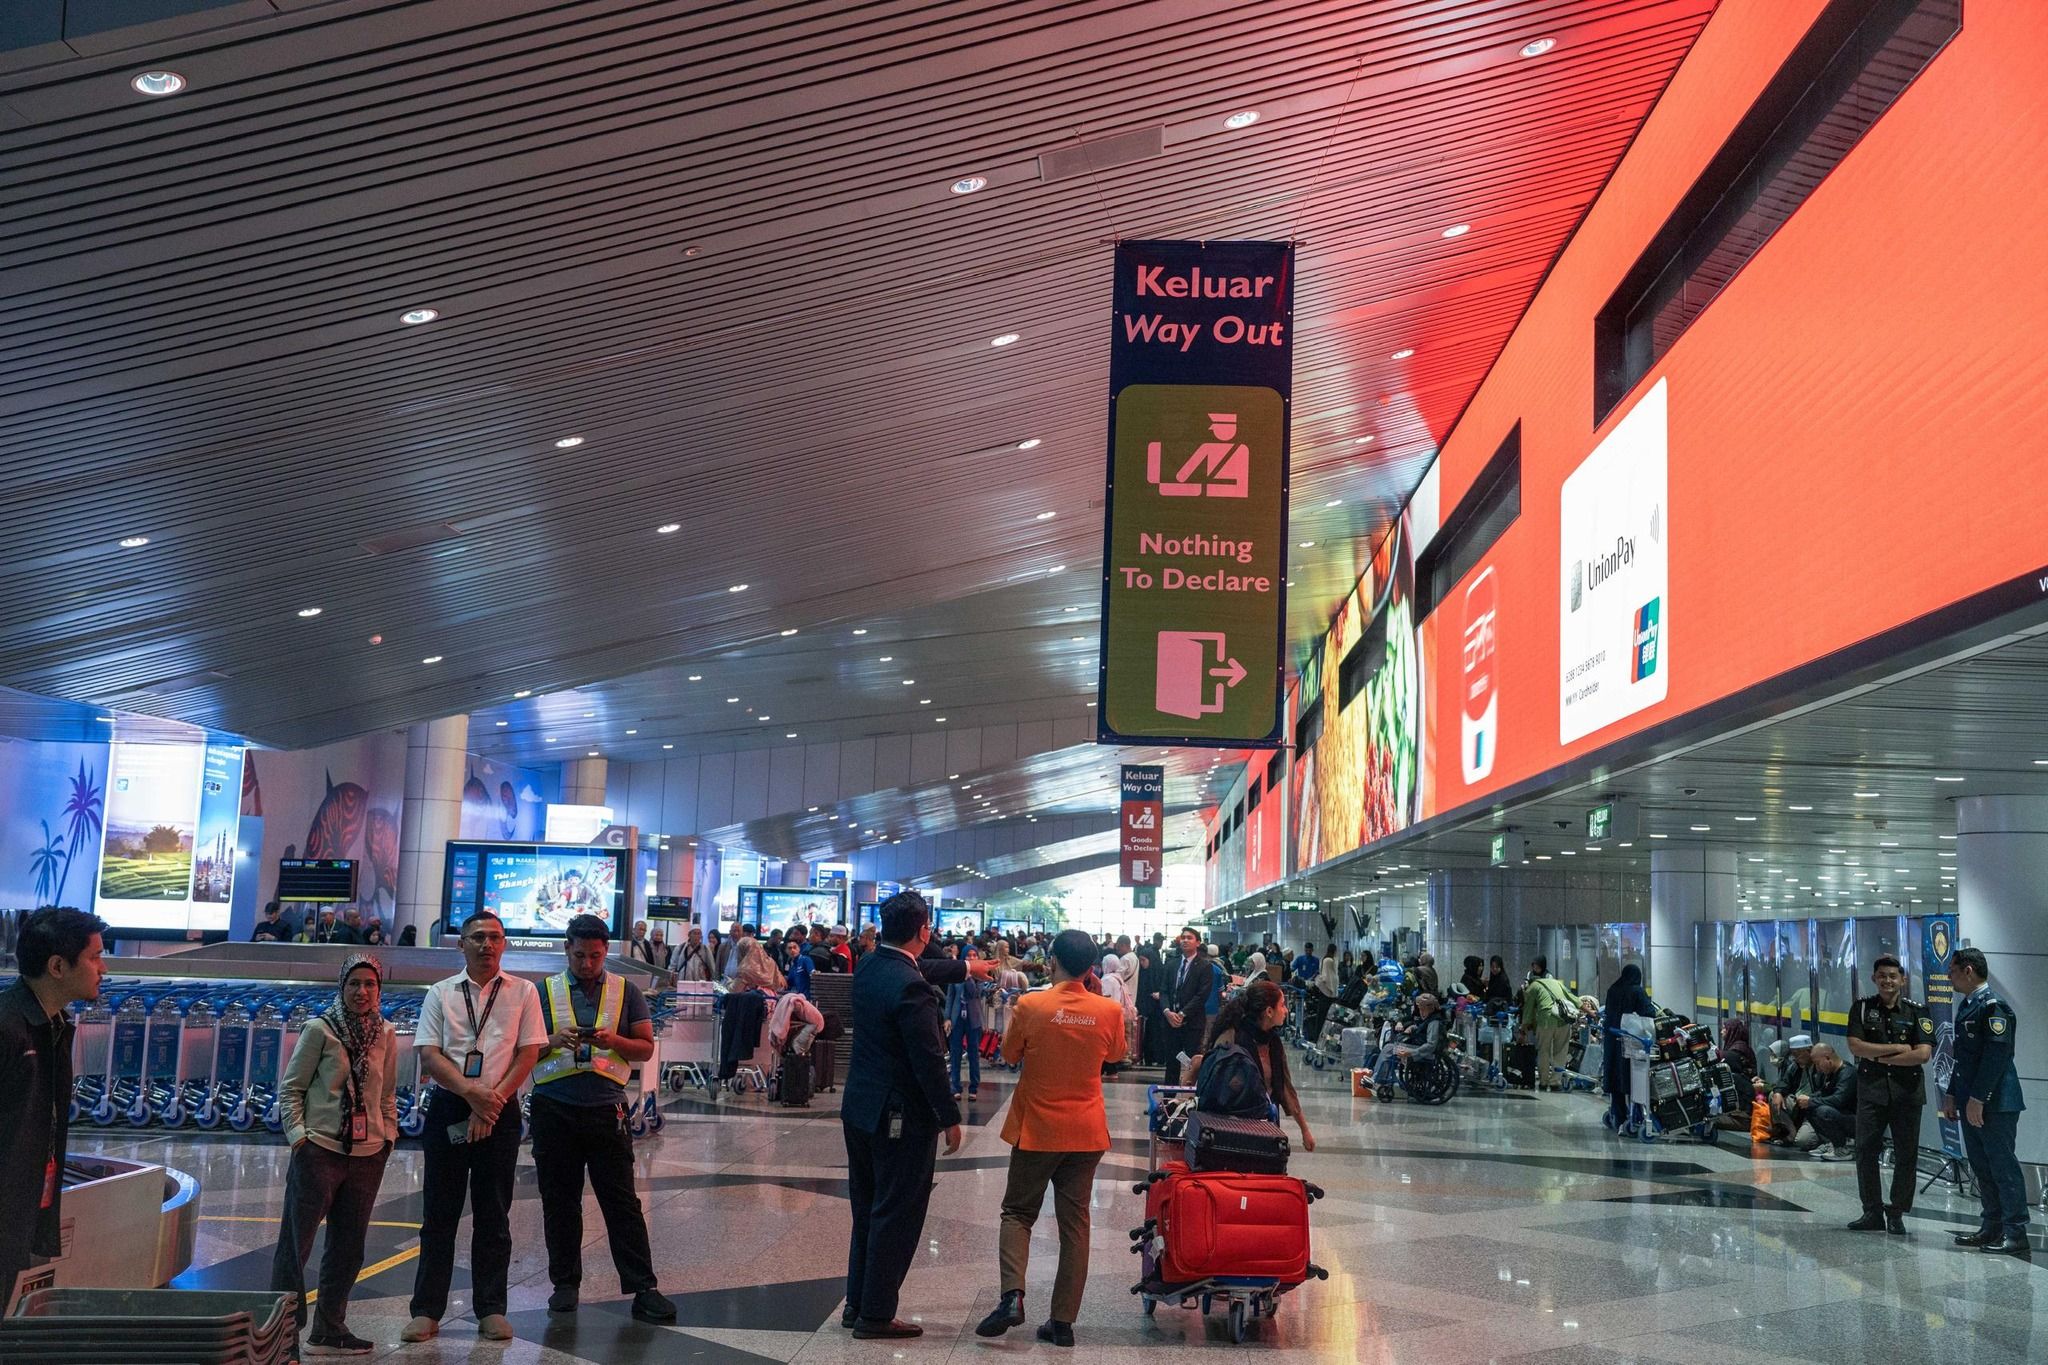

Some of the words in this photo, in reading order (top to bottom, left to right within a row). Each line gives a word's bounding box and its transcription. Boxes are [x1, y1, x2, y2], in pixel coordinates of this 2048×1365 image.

[1137, 265, 1274, 298] Keluar
[1124, 314, 1201, 352] Way
[1213, 315, 1284, 346] Out
[1140, 533, 1254, 563] Nothing
[1588, 536, 1636, 591] UnionPay
[1119, 567, 1153, 589] To
[1163, 568, 1270, 592] Declare
[1125, 771, 1160, 780] Keluar
[1122, 783, 1142, 793] Way
[1144, 783, 1162, 792] Out
[606, 829, 624, 847] G
[1133, 844, 1160, 852] Declare
[835, 879, 841, 889] F
